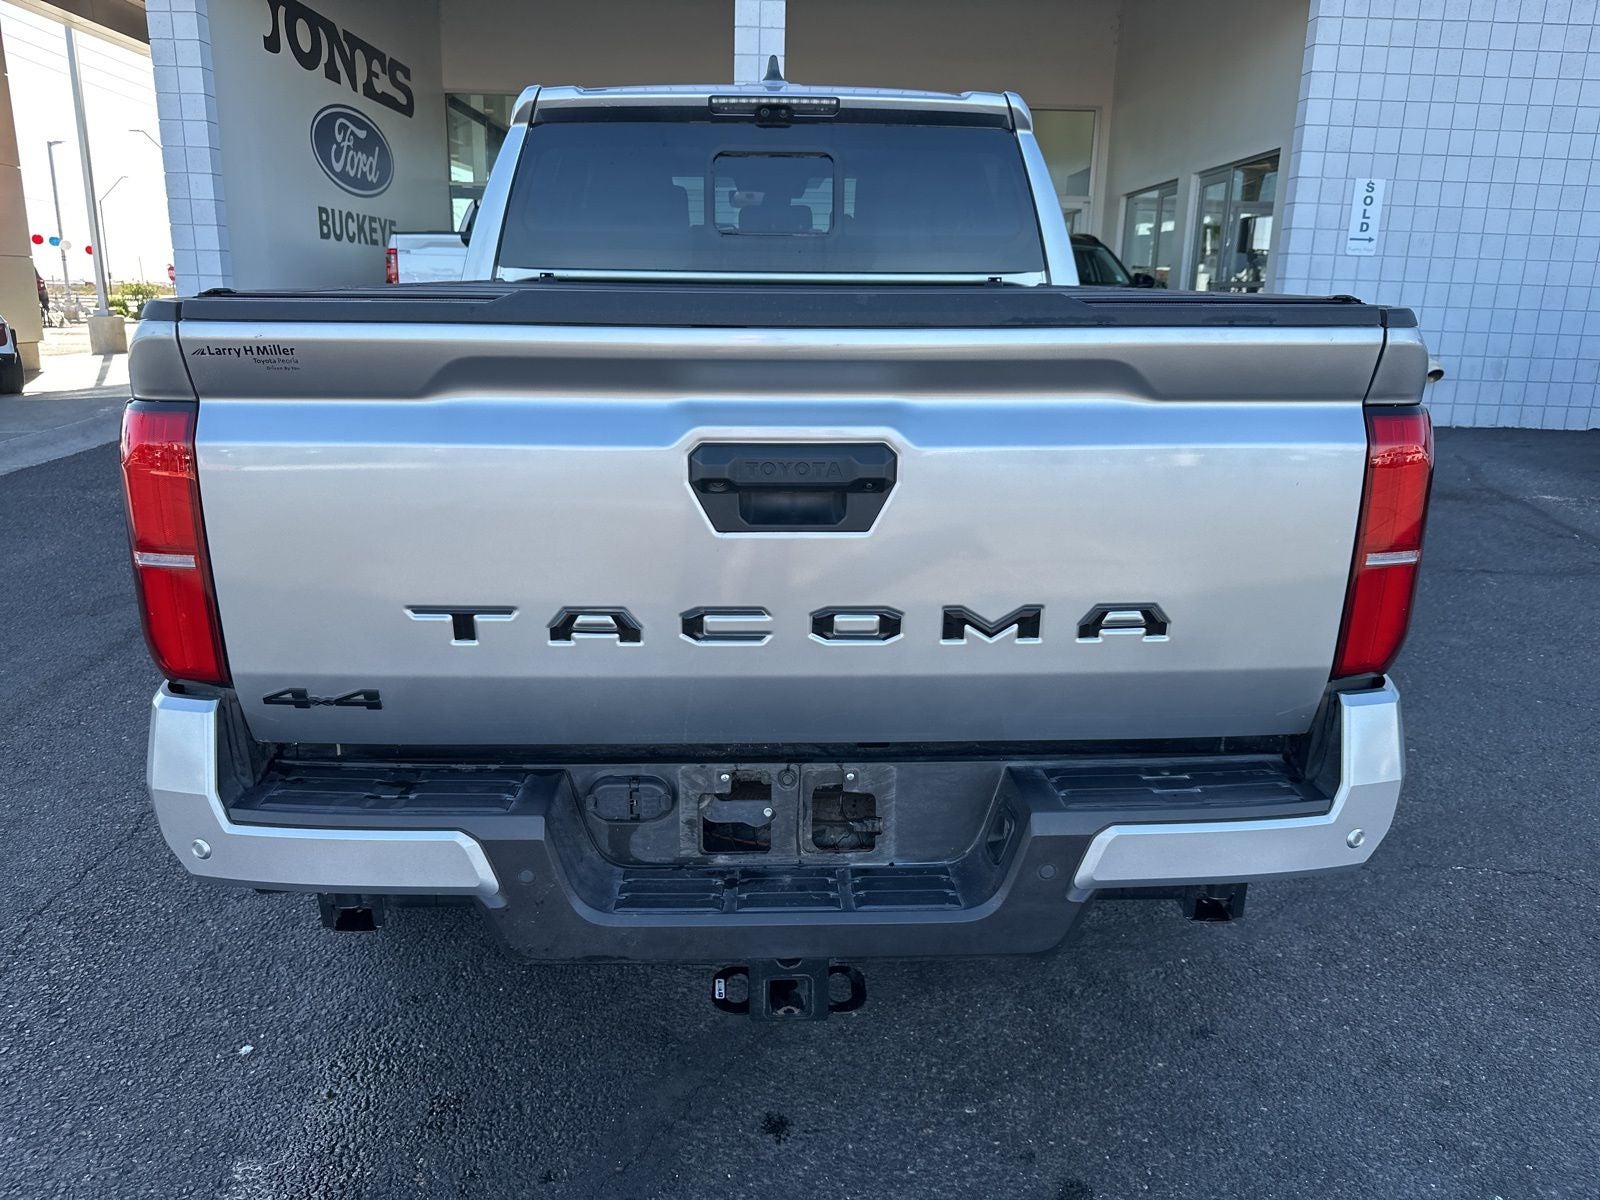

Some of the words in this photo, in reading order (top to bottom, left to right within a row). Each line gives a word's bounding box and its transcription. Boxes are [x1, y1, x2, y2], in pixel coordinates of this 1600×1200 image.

[263, 0, 414, 118] JONES
[331, 117, 380, 183] Ford
[1359, 182, 1375, 232] SOLD
[206, 345, 240, 357] Larry
[243, 346, 254, 356] H
[256, 344, 295, 356] Miller
[253, 357, 277, 365] Toyota
[745, 461, 842, 477] TOYOTA
[403, 602, 1171, 647] TACOMA
